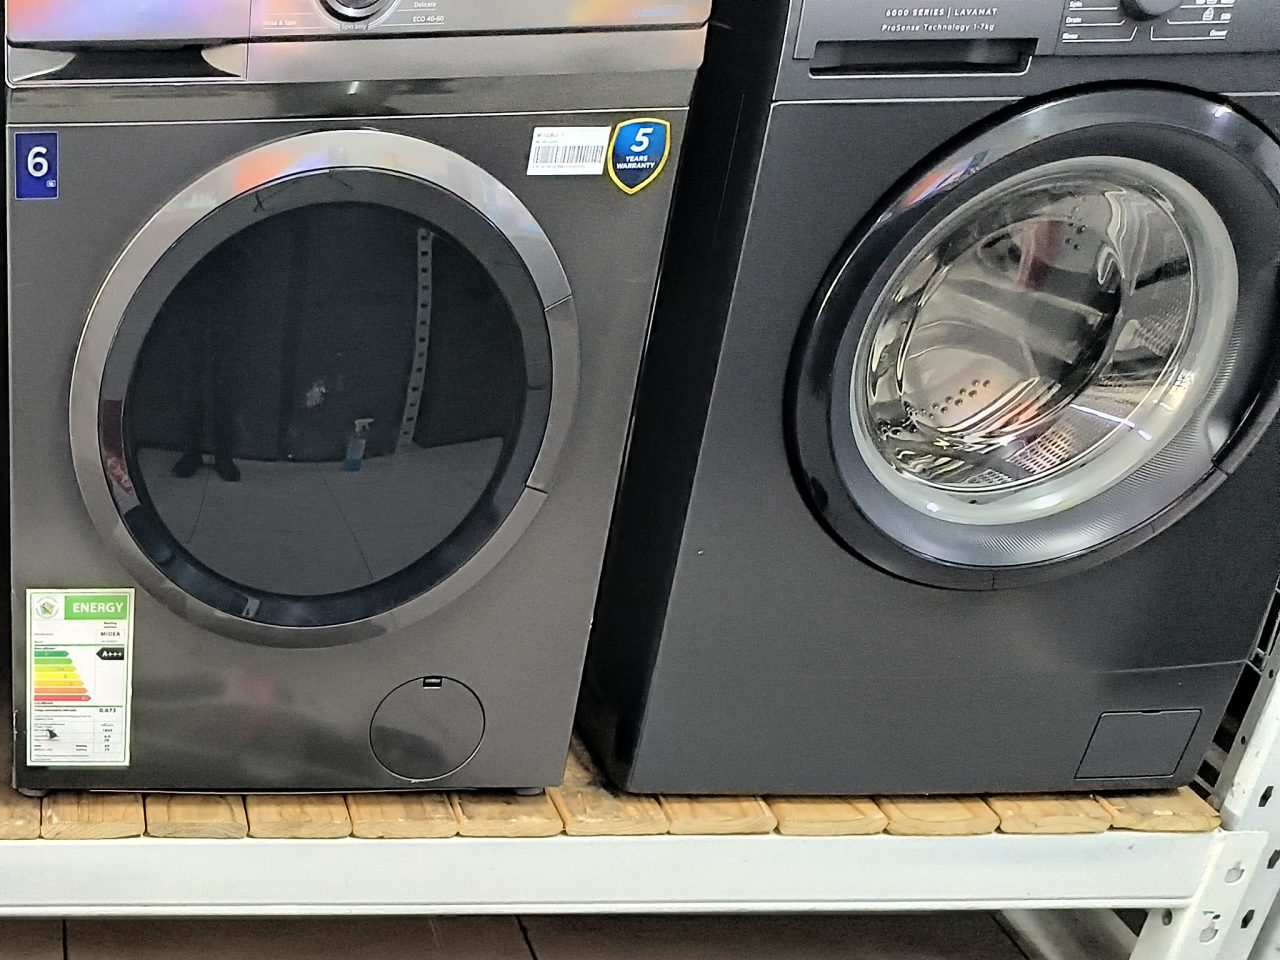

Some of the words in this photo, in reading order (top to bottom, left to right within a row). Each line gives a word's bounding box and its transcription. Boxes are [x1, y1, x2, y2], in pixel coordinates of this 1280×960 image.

[885, 8, 909, 17] 6000
[912, 8, 944, 16] SERIES
[954, 8, 998, 16] LAVAMAT
[425, 15, 445, 23] 40-60
[881, 24, 920, 32] ProSense
[923, 23, 970, 32] Technology
[972, 23, 995, 32] 1-7kg
[629, 127, 654, 153] 5
[27, 146, 49, 177] 6
[616, 161, 656, 170] WARRANTY
[72, 602, 123, 614] ENERGY
